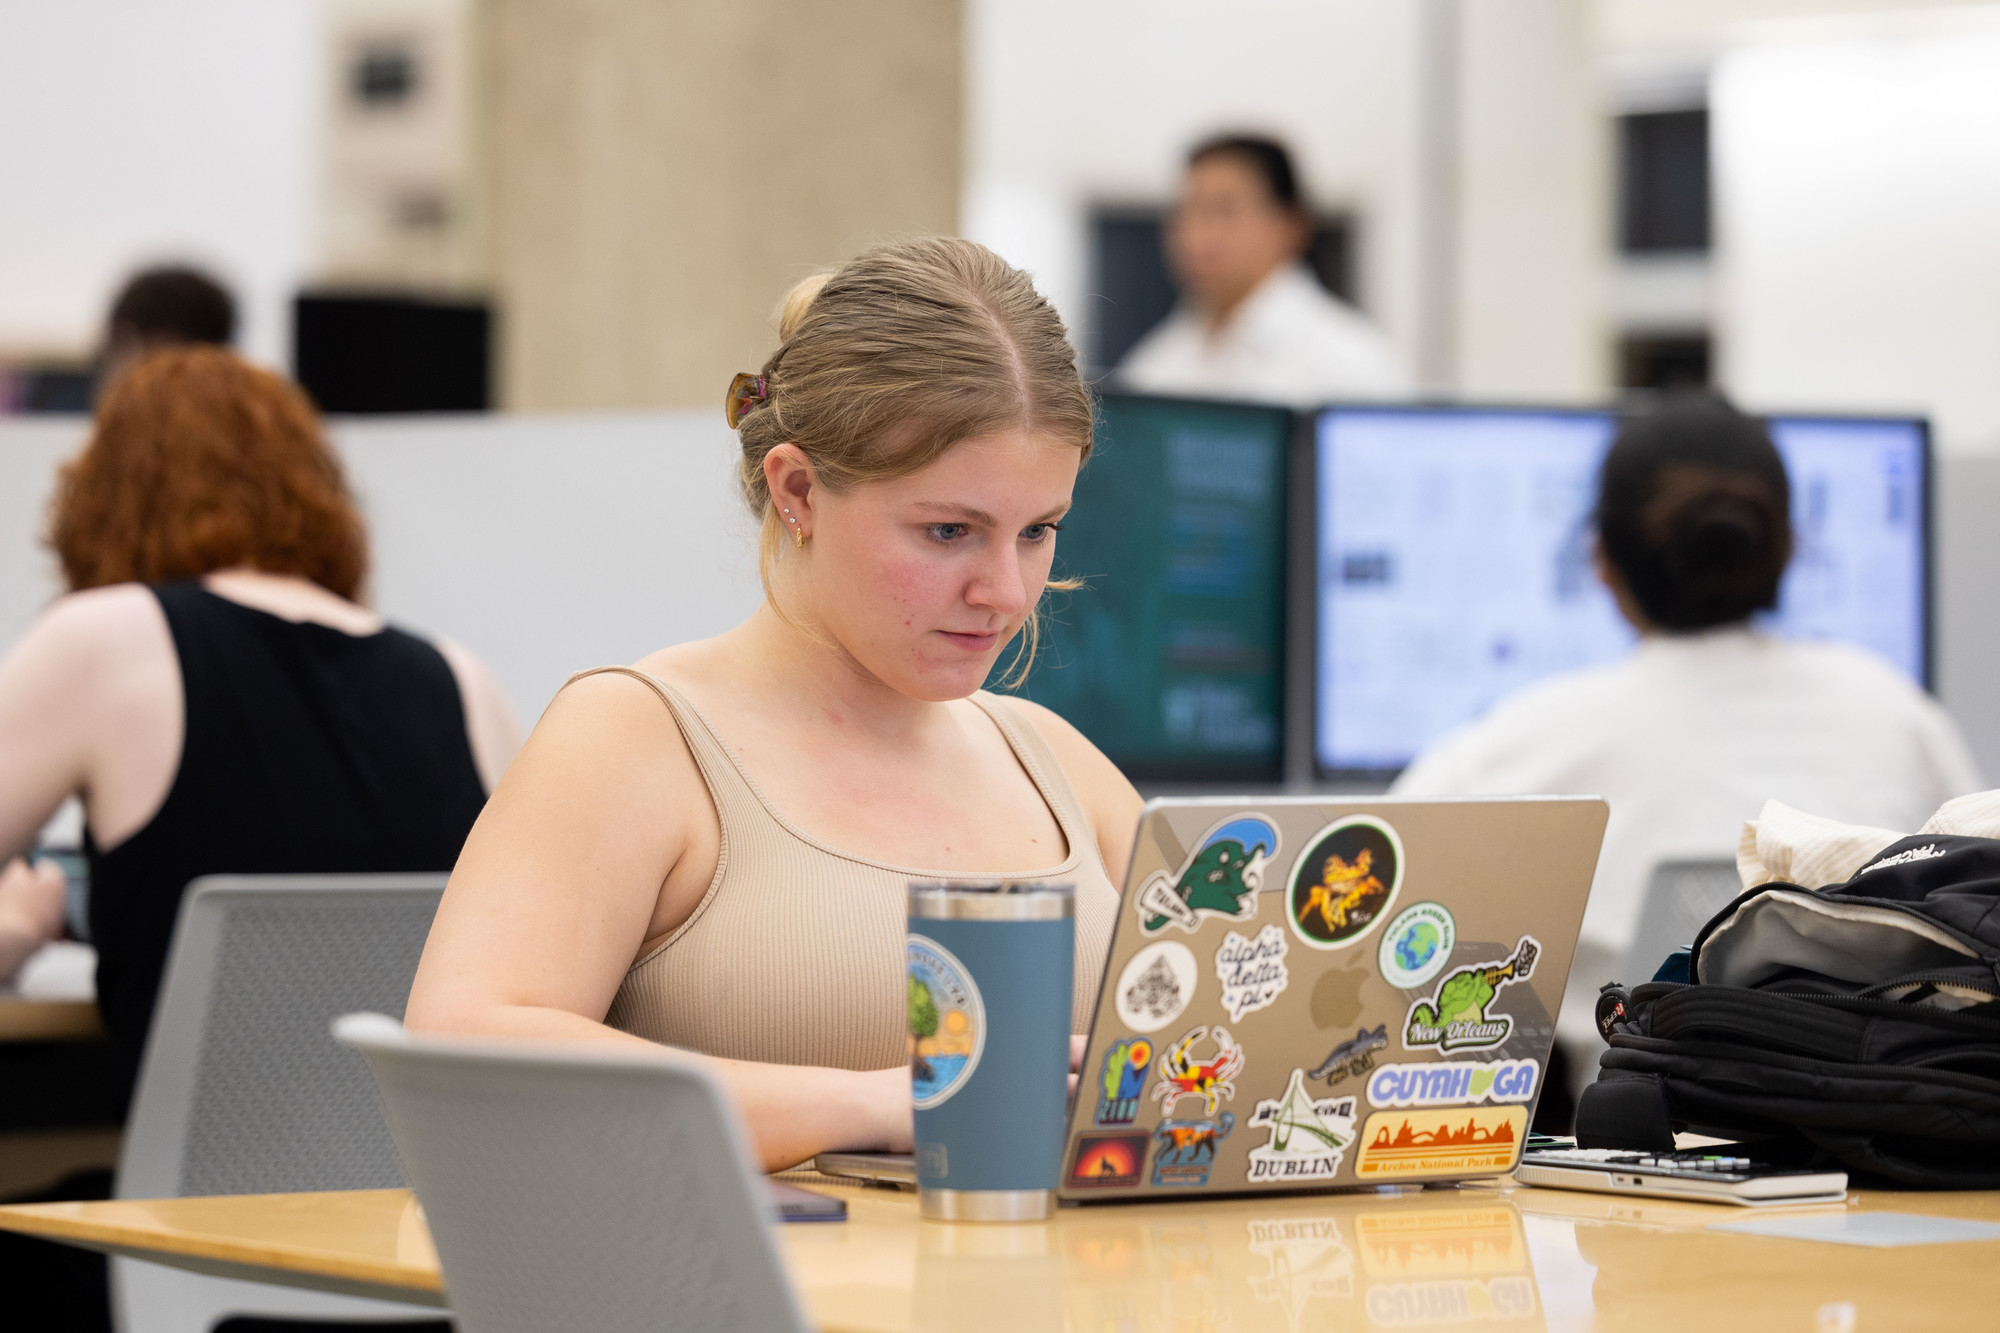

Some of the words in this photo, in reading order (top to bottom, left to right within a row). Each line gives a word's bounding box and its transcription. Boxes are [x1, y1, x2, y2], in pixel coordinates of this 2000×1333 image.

[1221, 942, 1283, 975] alpha
[1228, 963, 1283, 987] delta
[1236, 985, 1264, 1015] pi
[1602, 1002, 1624, 1029] REPEL
[1409, 1022, 1443, 1041] New
[1445, 1019, 1506, 1040] Orleans
[1101, 1100, 1139, 1121] ZION
[1253, 1157, 1338, 1177] DUBLIN
[1380, 1162, 1416, 1172] Arches
[1419, 1159, 1464, 1170] National
[1467, 1156, 1492, 1167] Park
